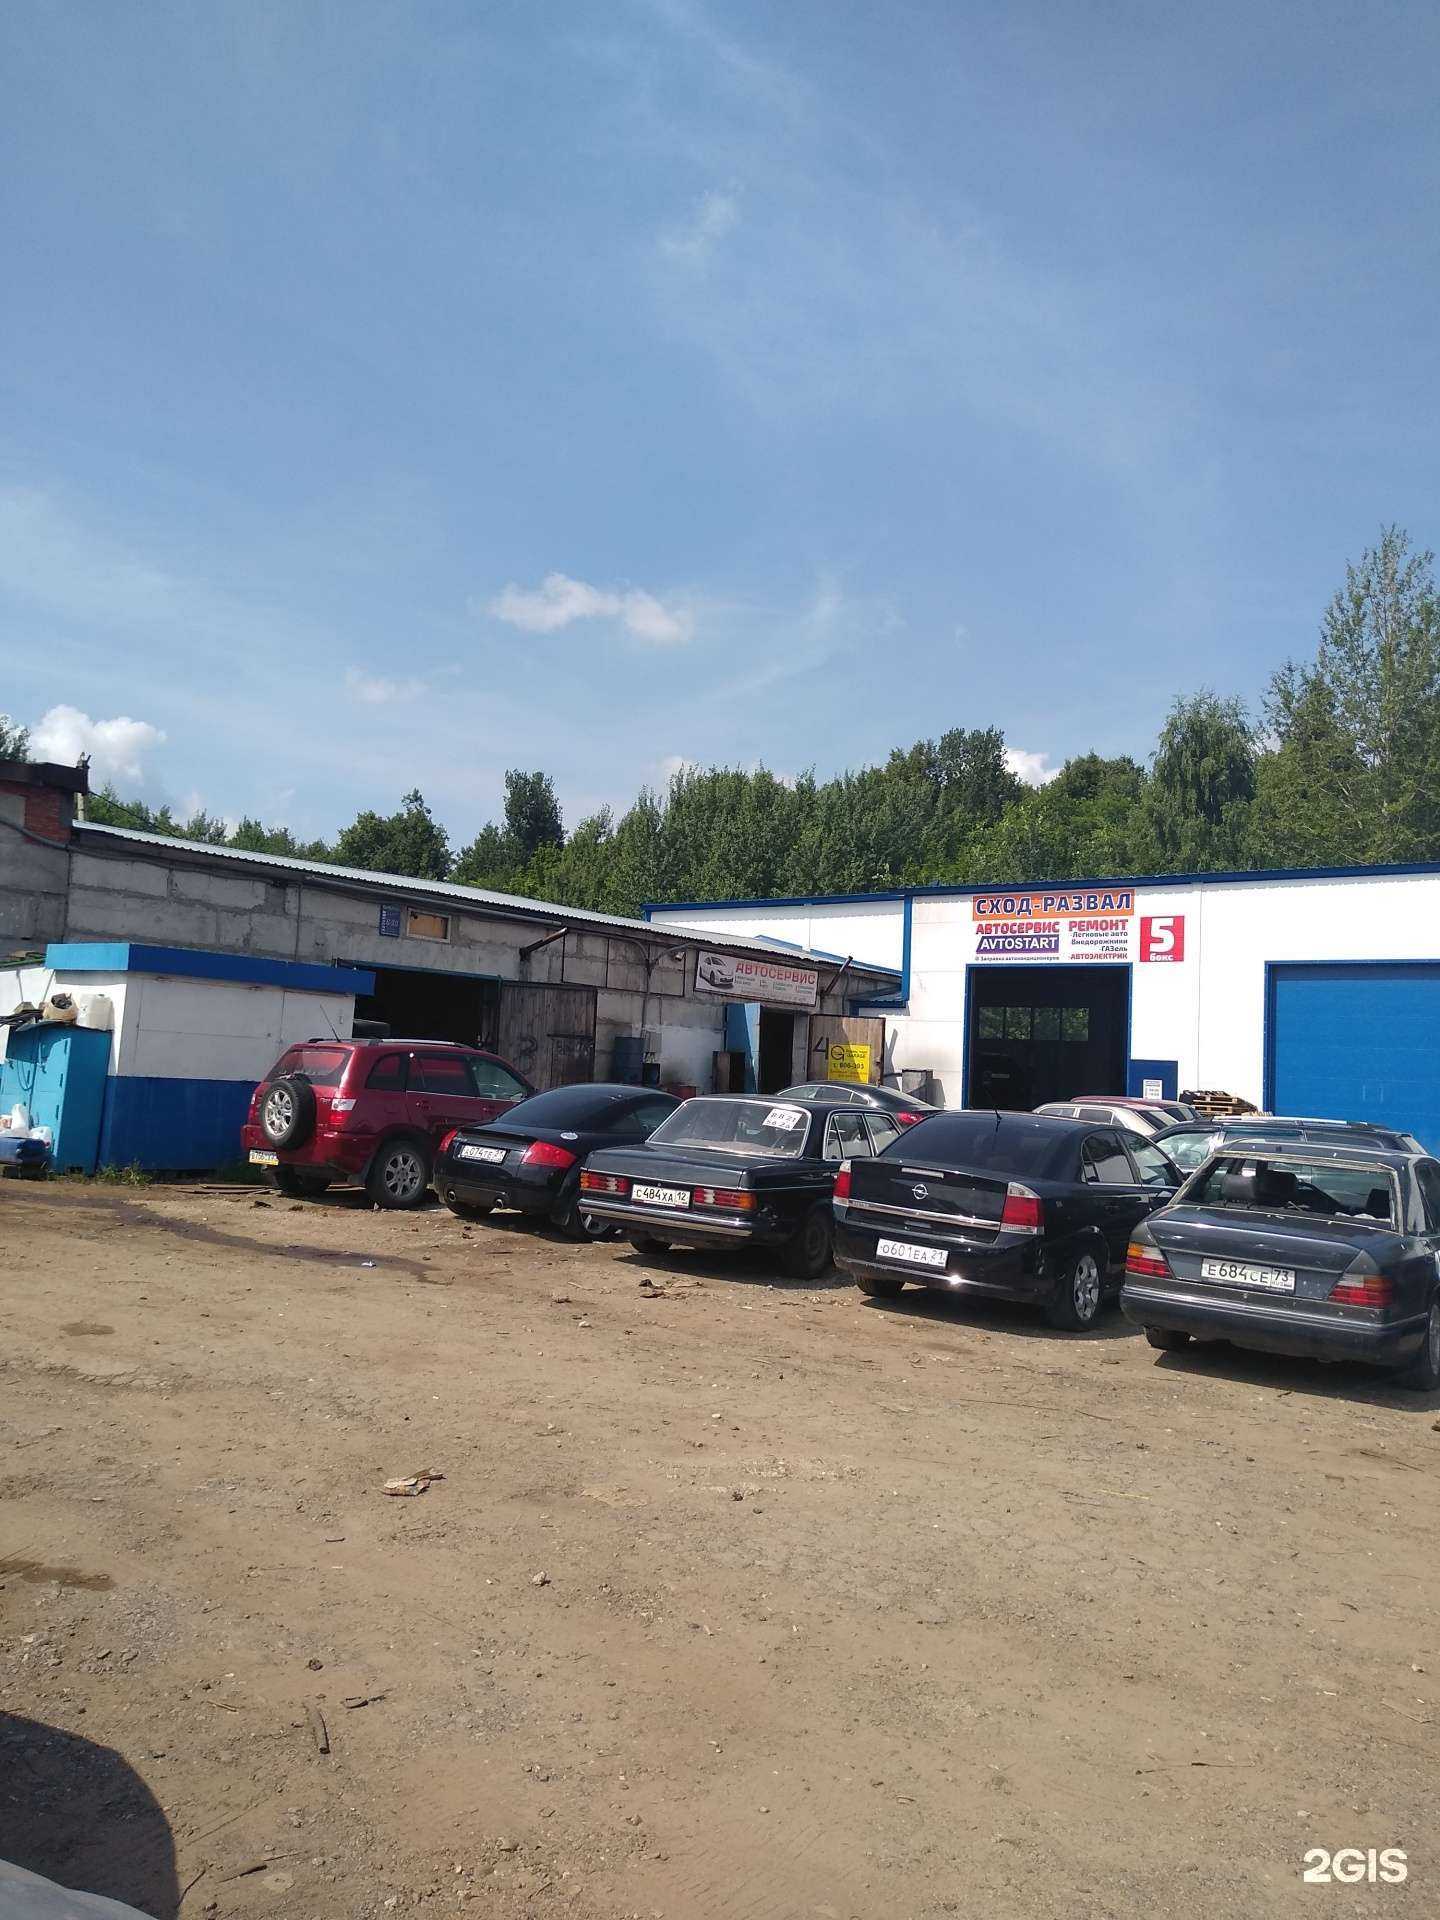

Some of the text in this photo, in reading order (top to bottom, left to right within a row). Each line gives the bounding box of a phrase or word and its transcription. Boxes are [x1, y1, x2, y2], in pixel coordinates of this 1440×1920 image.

[976, 893, 1131, 916] СХОД-РАЗВАЛ
[976, 921, 1060, 935] АВТОСЕРВИС
[1069, 919, 1128, 931] РЕМОНТ
[1150, 918, 1175, 953] 5
[981, 937, 1057, 950] AVTOSTART
[1150, 953, 1174, 962] бокс
[736, 962, 815, 985] АВТОСЕРВИС
[636, 1187, 687, 1202] С484ХА 12
[1208, 1263, 1289, 1284] Е684СЕ 73
